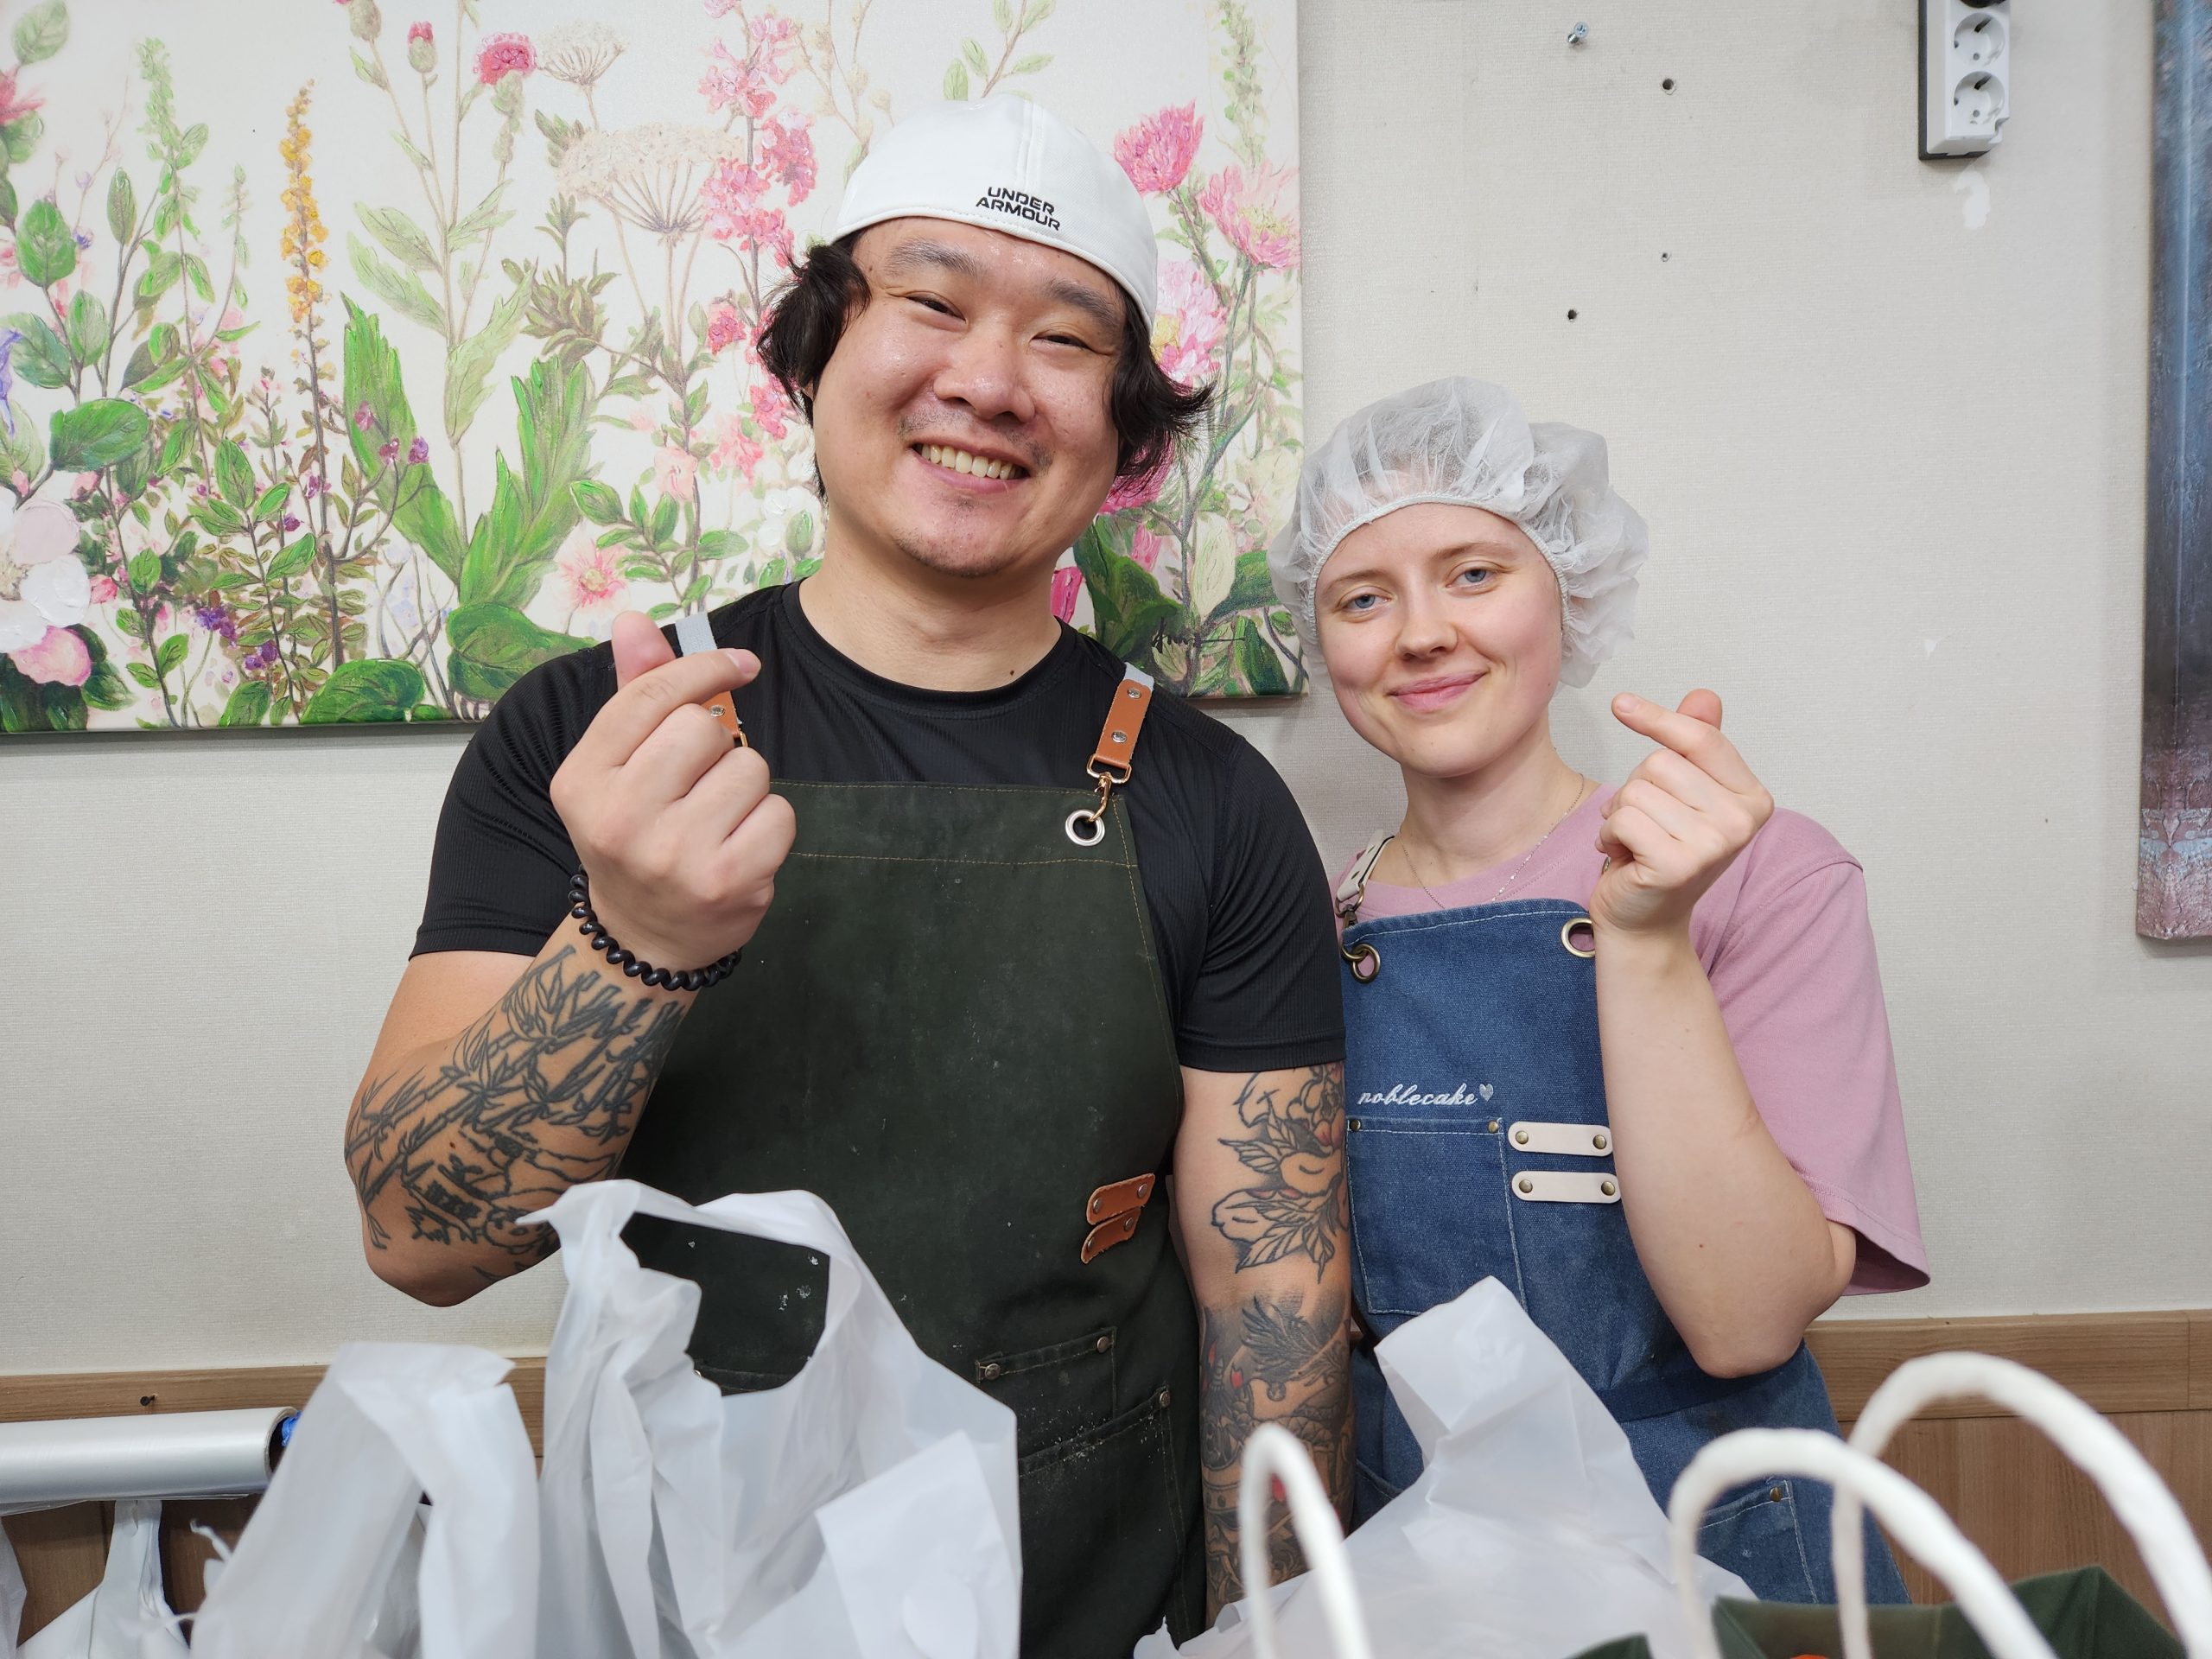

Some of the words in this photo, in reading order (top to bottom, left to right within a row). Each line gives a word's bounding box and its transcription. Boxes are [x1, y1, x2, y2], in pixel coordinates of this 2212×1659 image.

[976, 197, 1060, 231] ARMOUR
[988, 187, 1055, 215] UNDER
[1357, 1083, 1478, 1105] noblecake
